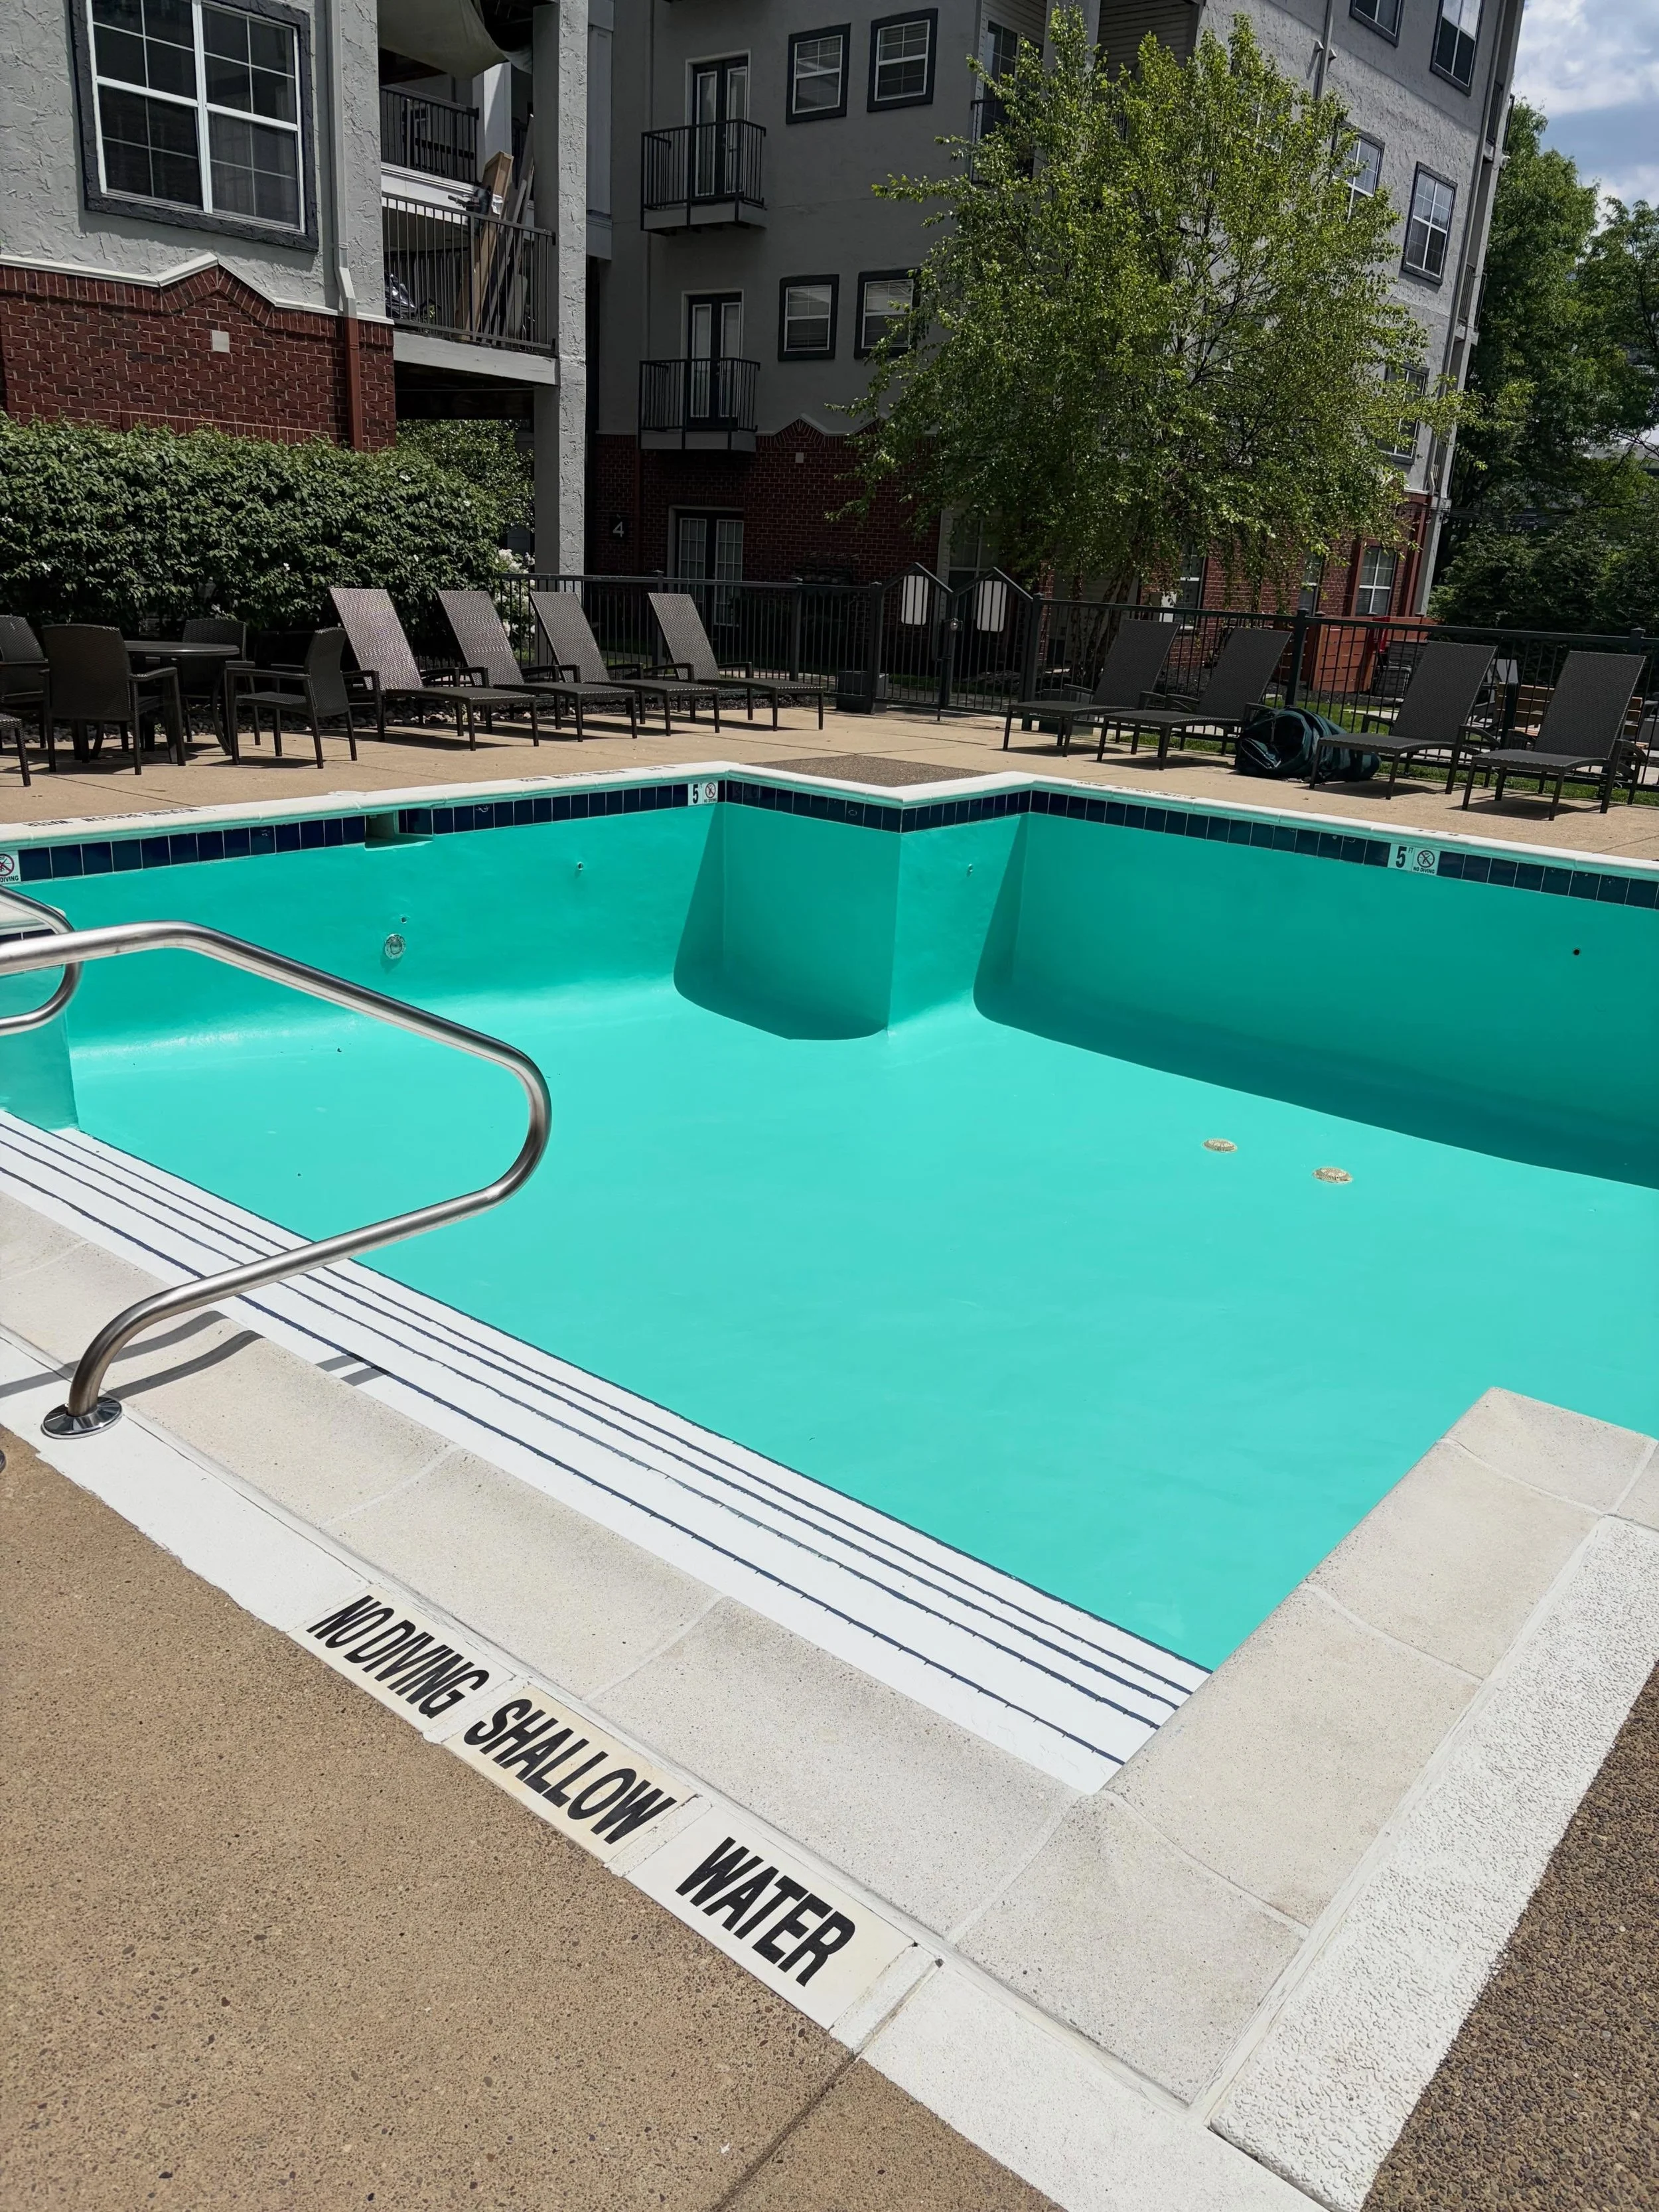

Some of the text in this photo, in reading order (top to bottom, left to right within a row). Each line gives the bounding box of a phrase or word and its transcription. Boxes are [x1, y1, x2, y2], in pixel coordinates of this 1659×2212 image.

[613, 521, 624, 538] 4
[693, 784, 699, 804] 5
[1396, 846, 1407, 868] 5
[305, 1595, 856, 1988] NO DIVING SHALLOW WATER
